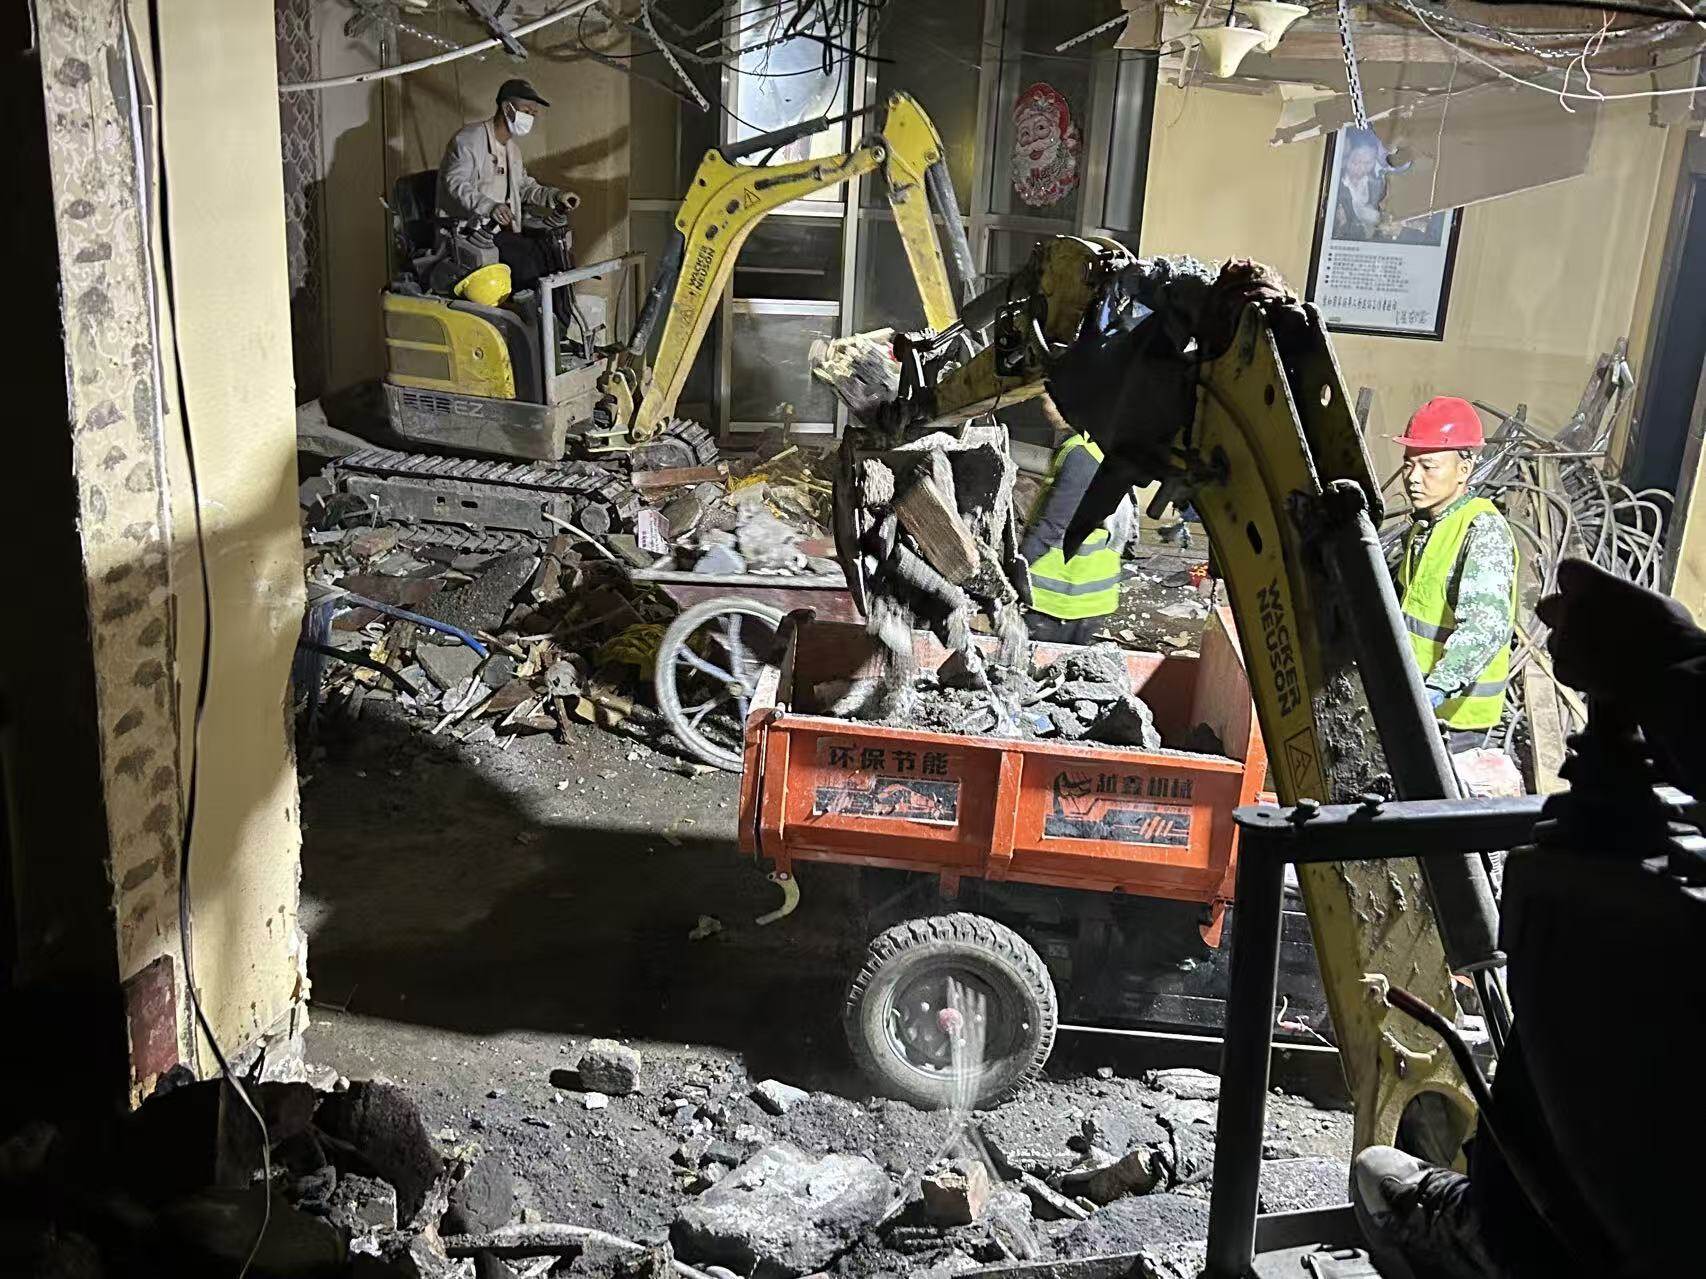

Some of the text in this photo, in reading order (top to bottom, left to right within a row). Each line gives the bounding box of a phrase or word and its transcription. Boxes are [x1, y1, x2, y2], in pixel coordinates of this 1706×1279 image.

[689, 246, 707, 286] WACKER
[695, 248, 715, 290] NEUSON
[1256, 587, 1293, 717] NEUSON
[1268, 577, 1301, 708] WACKER
[828, 745, 949, 775] 环保节能
